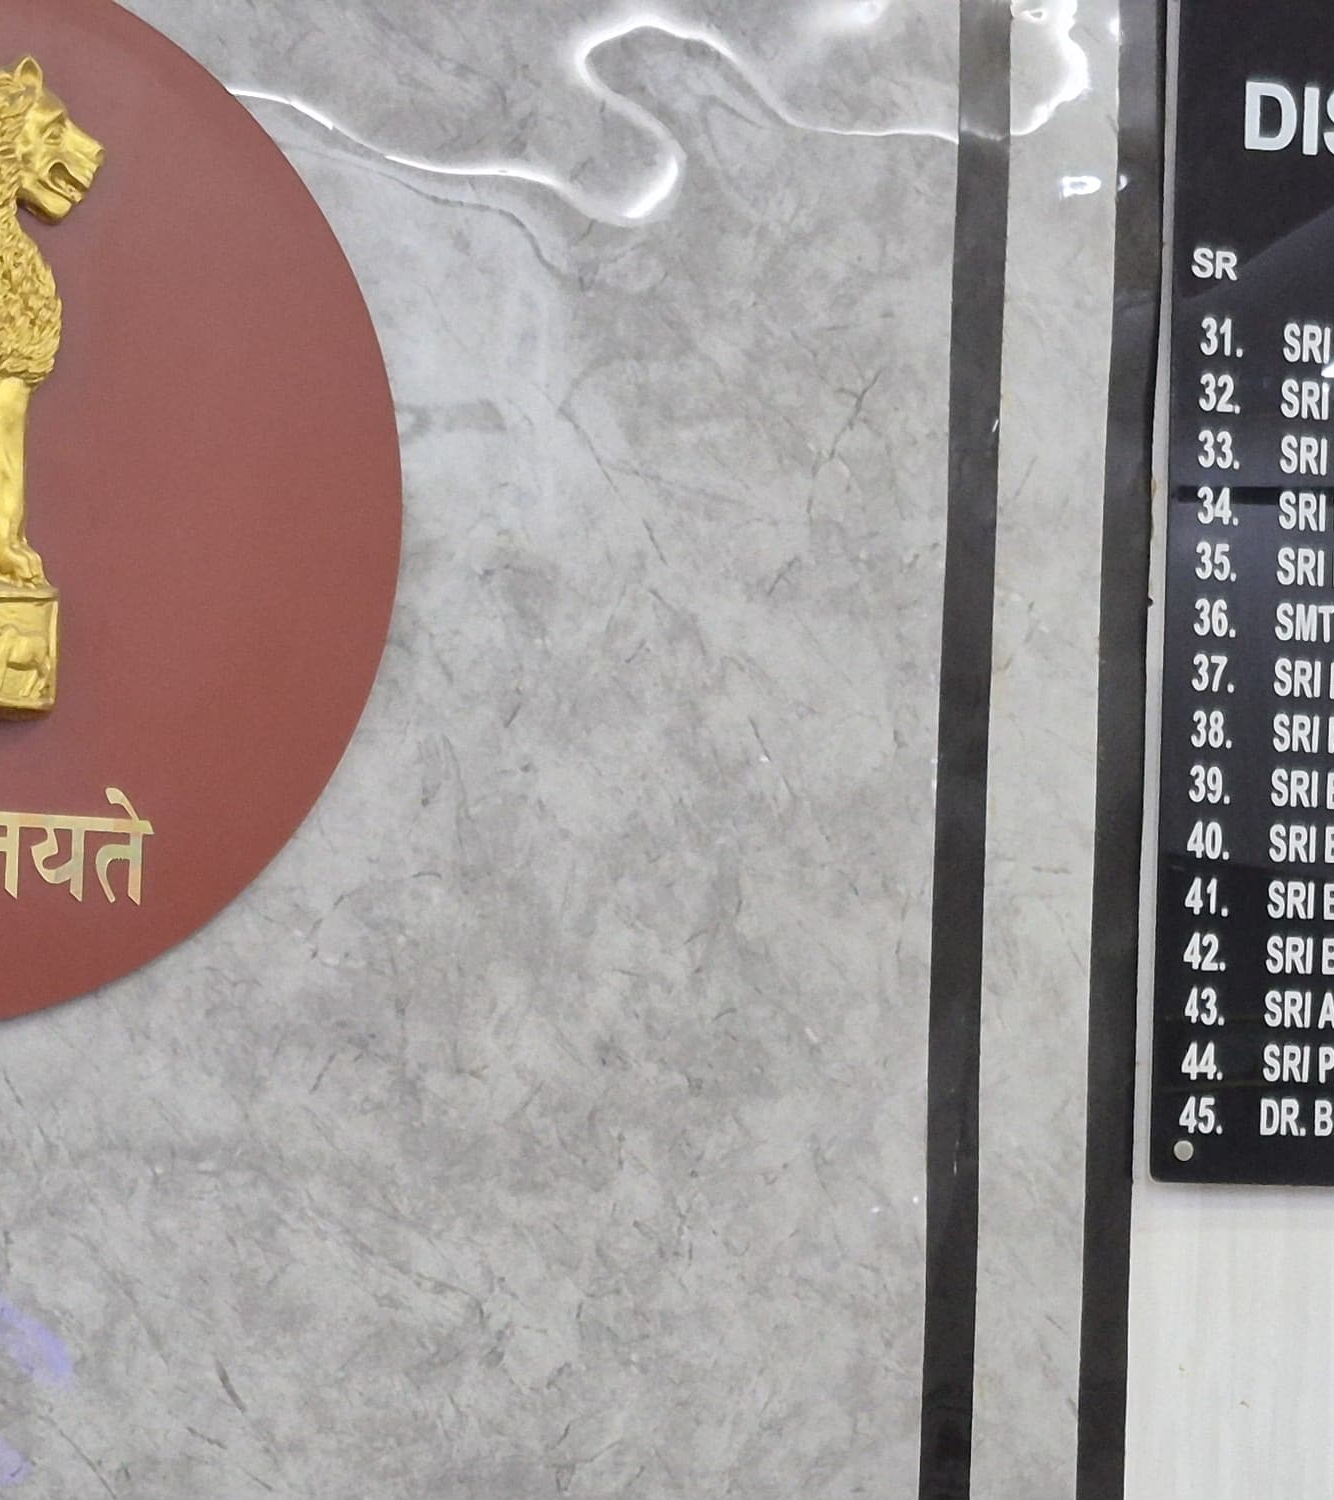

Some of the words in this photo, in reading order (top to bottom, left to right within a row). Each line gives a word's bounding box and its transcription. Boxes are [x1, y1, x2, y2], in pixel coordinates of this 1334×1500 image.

[1191, 247, 1238, 281] SR
[1200, 316, 1243, 357] 31.
[1282, 323, 1330, 364] SRI
[1199, 373, 1241, 414] 32.
[1281, 380, 1329, 421] SRI
[1198, 429, 1240, 470] 33.
[1280, 435, 1327, 476] SRI
[1197, 486, 1239, 527] 34.
[1278, 491, 1325, 532] SRI
[1195, 543, 1237, 582] 35.
[1276, 547, 1324, 588] SRI
[1193, 599, 1236, 638] 36.
[1275, 604, 1334, 644] SMT
[1192, 654, 1234, 694] 37.
[1273, 659, 1321, 698] SRI
[1191, 710, 1232, 749] 38.
[1273, 714, 1319, 754] SRI
[1189, 766, 1230, 805] 39.
[1271, 769, 1317, 808] SRI
[1187, 821, 1229, 861] 40.
[1269, 825, 1316, 863] SRI
[1185, 878, 1228, 917] 41.
[1267, 881, 1314, 920] SRI
[1183, 933, 1226, 972] 42.
[1266, 936, 1312, 974] SRI
[1184, 987, 1225, 1027] 43.
[1265, 991, 1311, 1029] SRI
[1182, 1042, 1223, 1081] 44.
[1264, 1044, 1309, 1083] SRI
[1179, 1096, 1222, 1135] 45.
[1260, 1099, 1306, 1137] DR.
